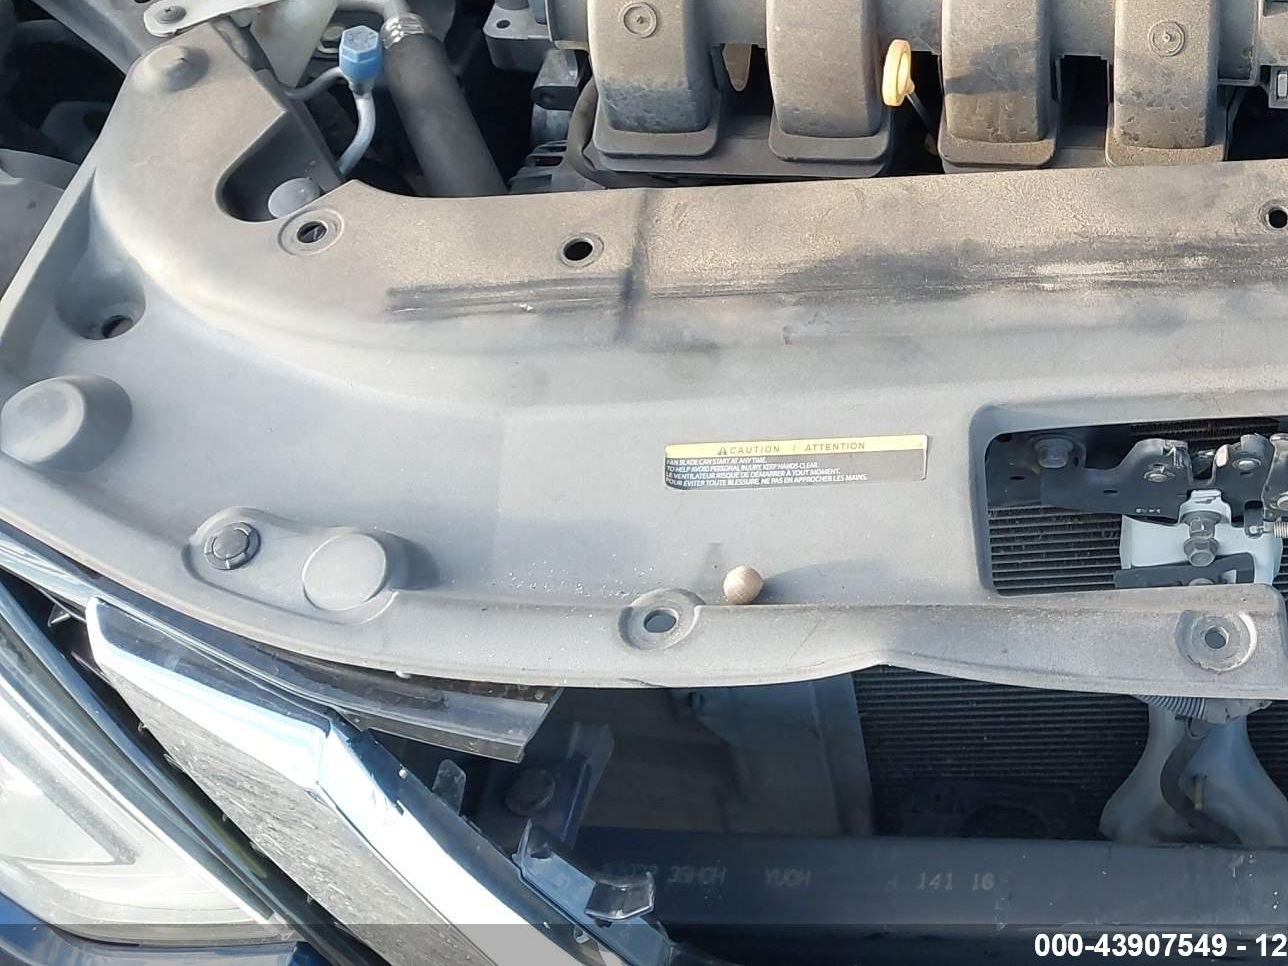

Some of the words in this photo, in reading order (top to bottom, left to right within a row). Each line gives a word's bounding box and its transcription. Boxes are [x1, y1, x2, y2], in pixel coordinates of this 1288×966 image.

[730, 445, 780, 454] CAUTION
[804, 442, 865, 451] ATTENTION
[673, 471, 715, 479] VENTILATEUR
